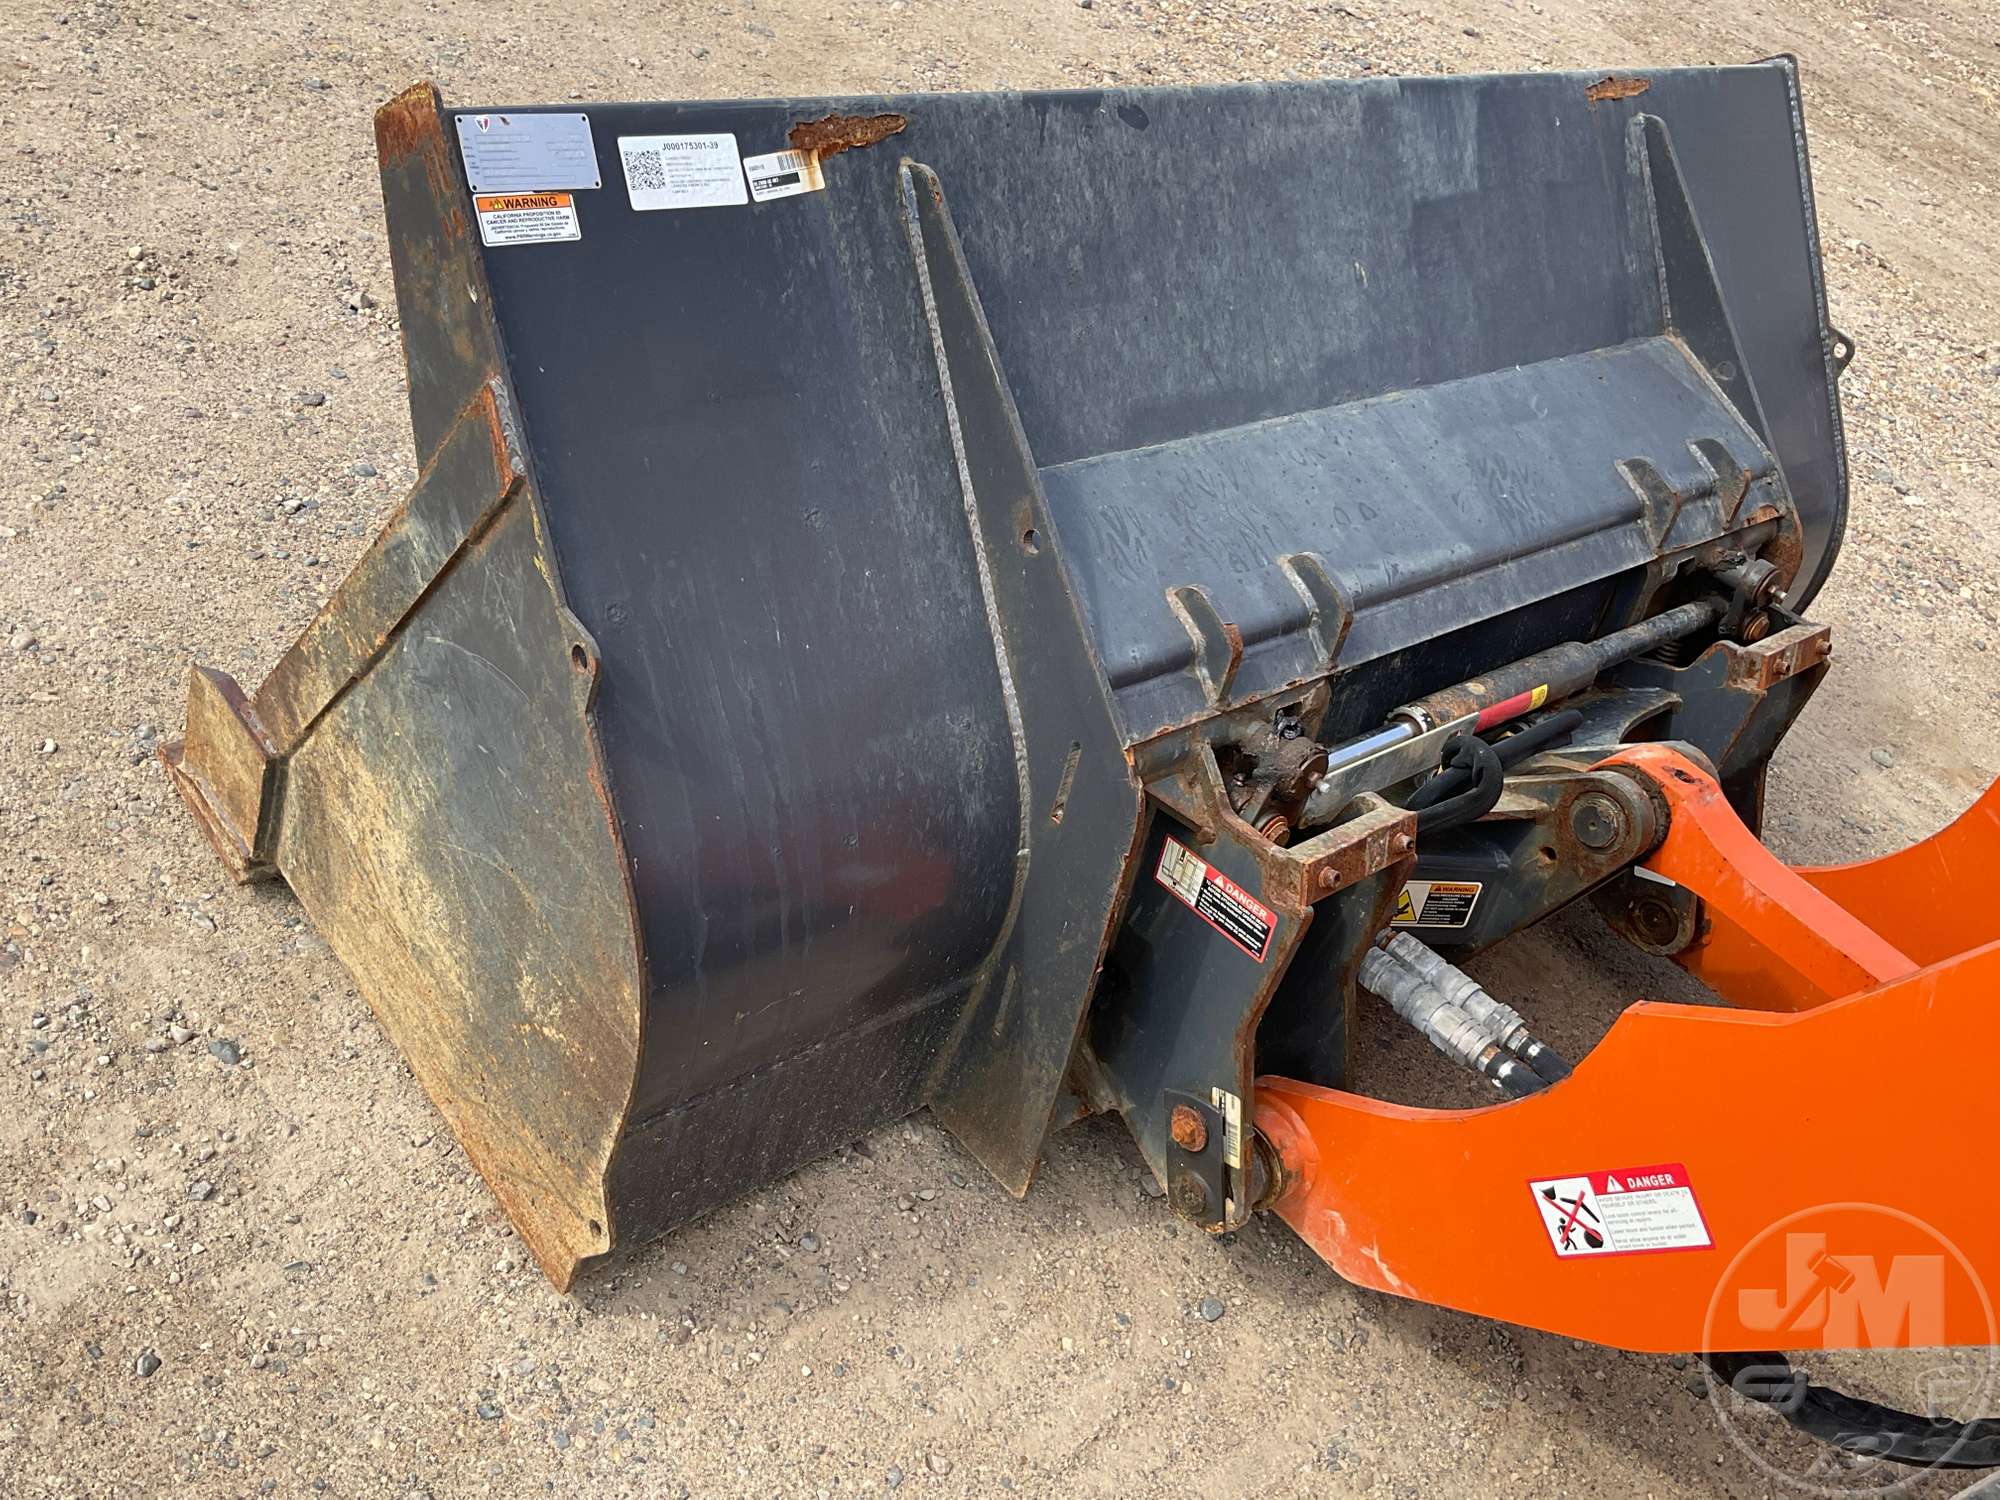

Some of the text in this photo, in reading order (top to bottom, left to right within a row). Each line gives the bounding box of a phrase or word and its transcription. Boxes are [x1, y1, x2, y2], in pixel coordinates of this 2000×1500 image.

[662, 141, 719, 151] J000175301-39
[503, 196, 557, 209] WARNING
[1225, 883, 1268, 920] DANGER
[1626, 1173, 1675, 1189] DANGER
